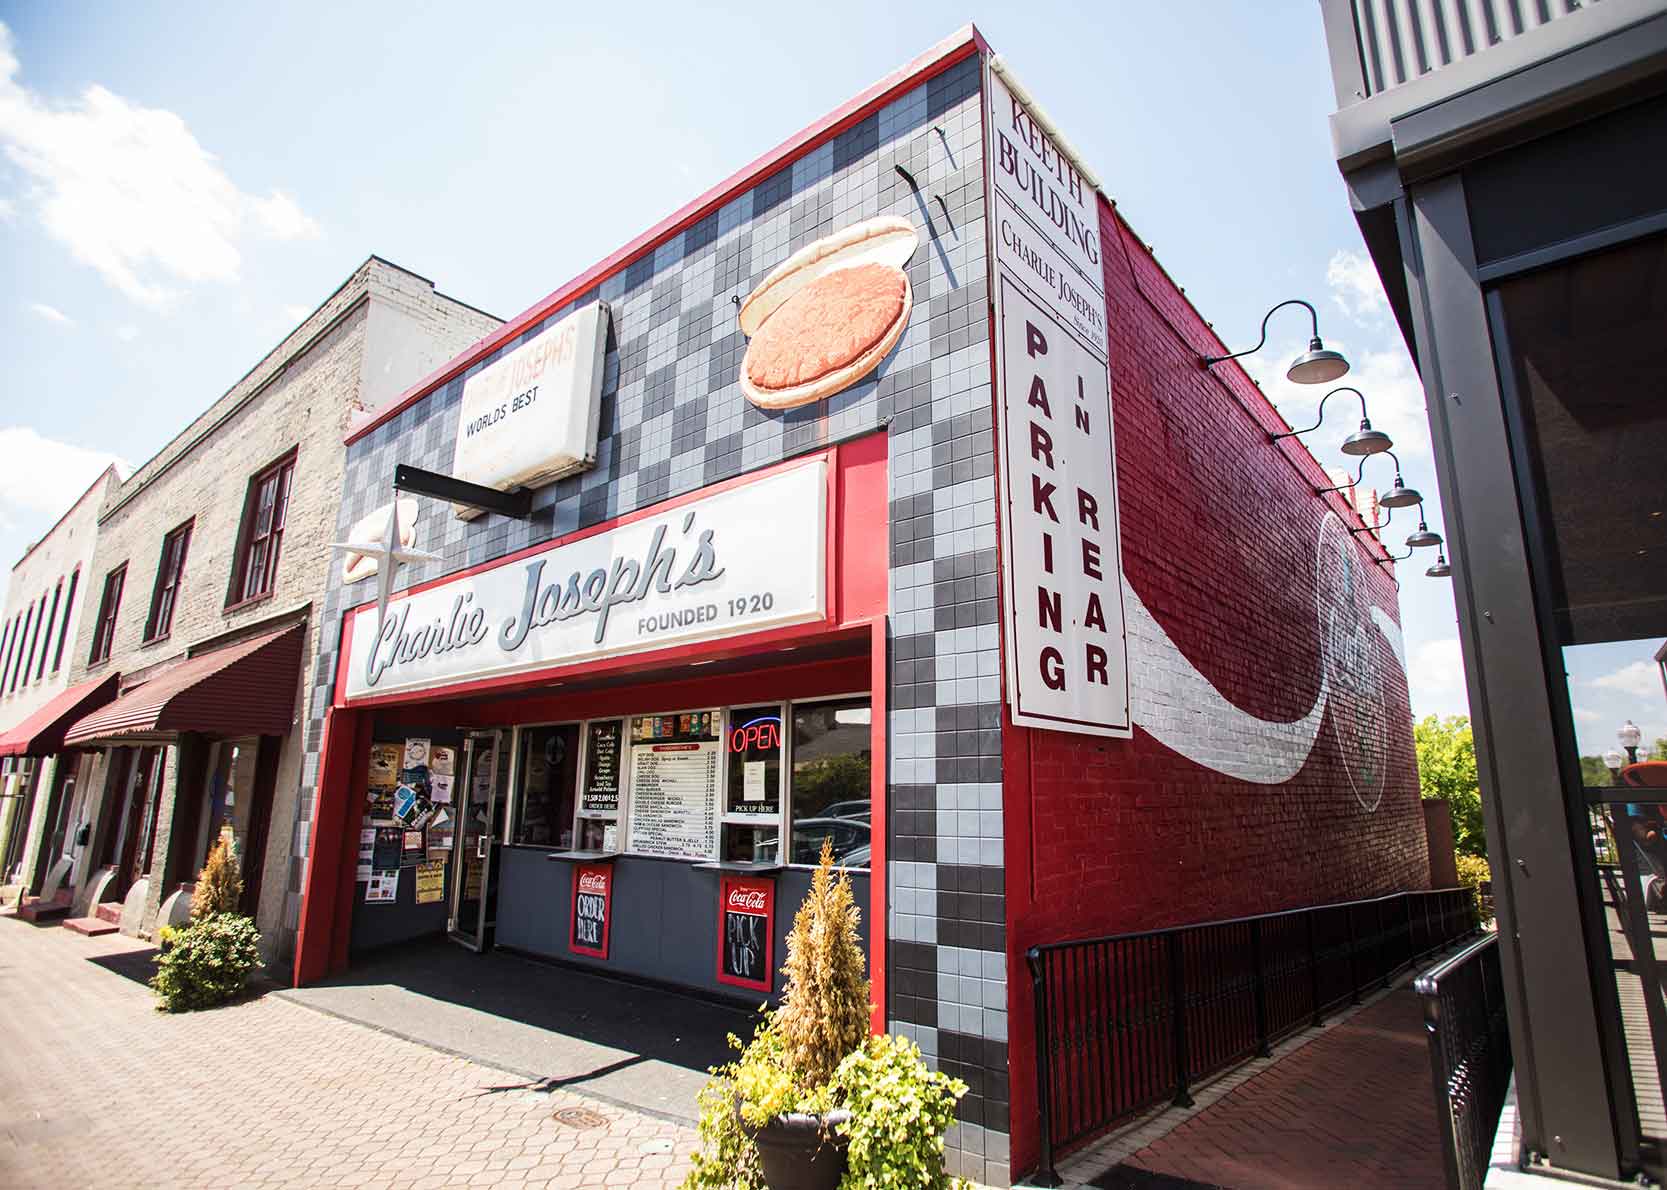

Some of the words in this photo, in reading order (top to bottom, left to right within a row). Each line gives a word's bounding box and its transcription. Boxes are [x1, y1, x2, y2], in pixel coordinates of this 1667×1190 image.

[1009, 93, 1084, 208] KEETH
[998, 128, 1098, 265] BUILDING
[1001, 219, 1056, 289] CHARLIE
[1058, 272, 1104, 333] JOSEPH'S
[466, 404, 507, 439] WORLDS
[512, 386, 539, 413] BEST
[1075, 375, 1090, 436] IN
[1026, 319, 1066, 692] PARKING
[366, 592, 489, 687] Charlie
[498, 511, 725, 651] Joseph's
[638, 604, 718, 635] FOUNDED
[727, 591, 774, 618] 1920
[1077, 487, 1109, 686] REAR
[733, 724, 781, 752] OPEN
[577, 894, 605, 922] ORDER
[729, 889, 767, 909] Coca-Cola
[577, 917, 599, 943] HERE
[728, 914, 760, 951] PICK
[732, 943, 755, 977] UP
